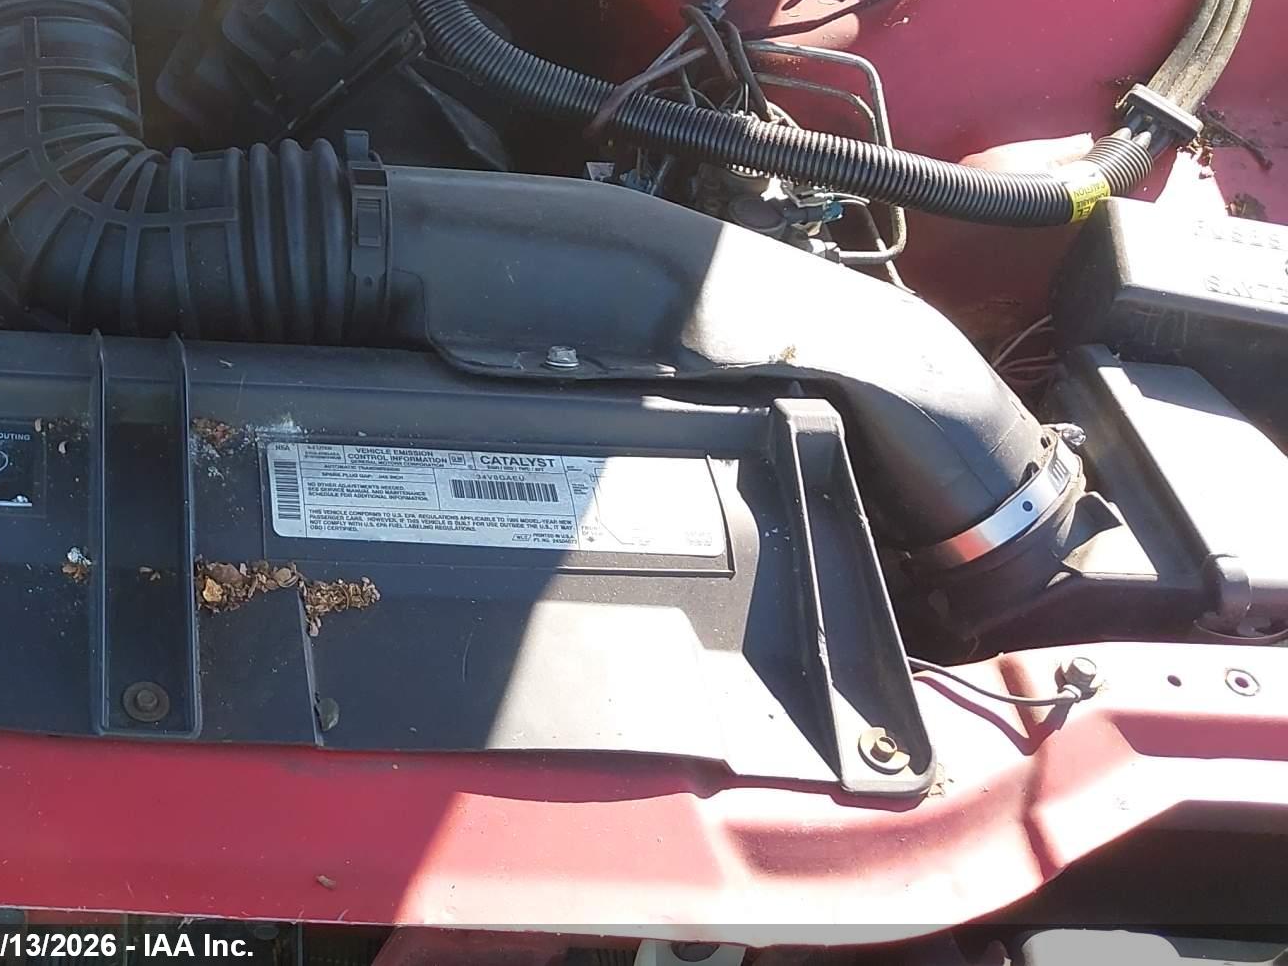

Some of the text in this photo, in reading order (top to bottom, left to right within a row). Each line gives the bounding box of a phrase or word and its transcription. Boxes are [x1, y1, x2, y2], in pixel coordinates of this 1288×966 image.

[355, 447, 433, 456] VEHICLE EMISSION
[347, 453, 388, 461] CONTROL
[390, 454, 447, 463] INFORMATION
[479, 455, 556, 468] CATALYST
